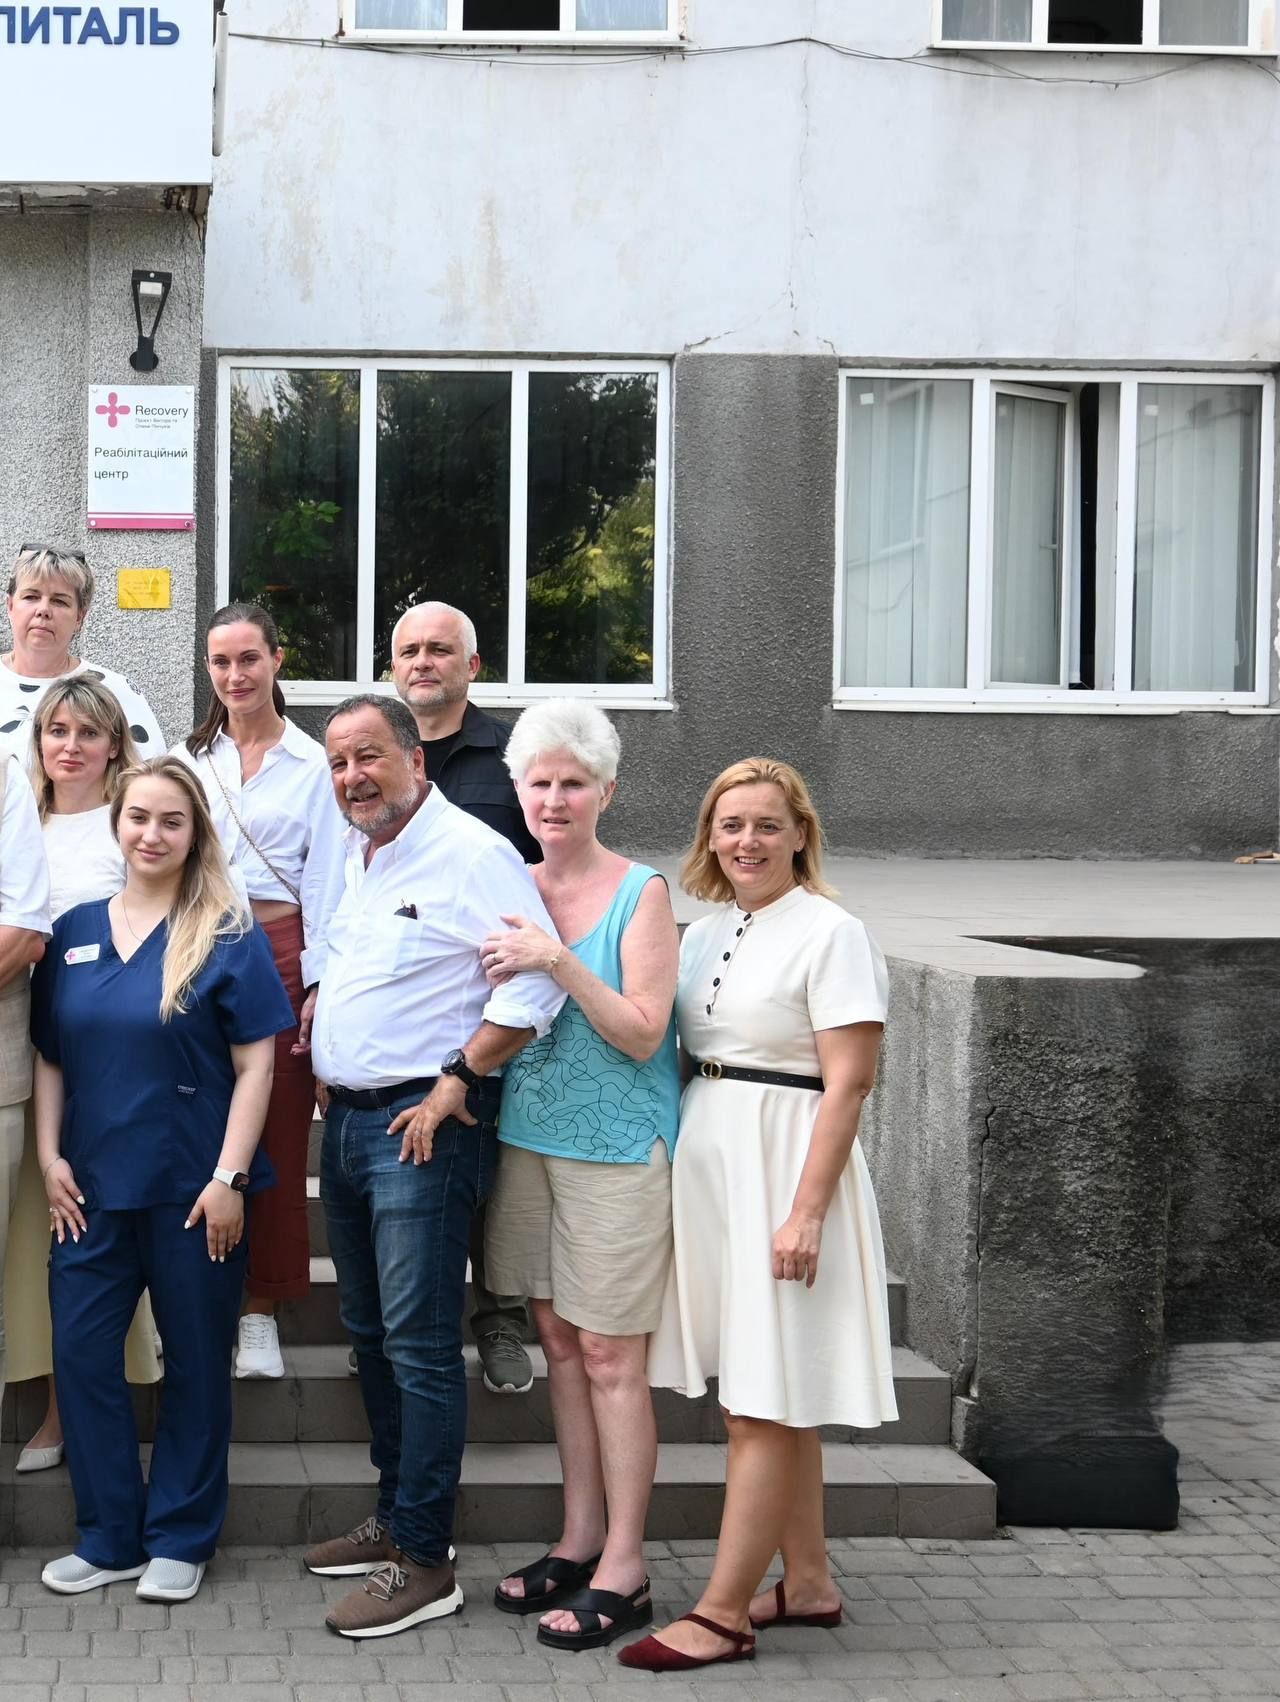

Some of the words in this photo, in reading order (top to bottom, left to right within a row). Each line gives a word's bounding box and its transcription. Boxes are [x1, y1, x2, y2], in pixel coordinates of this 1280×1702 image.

[135, 405, 189, 418] Recovery
[94, 447, 188, 459] Реабілітаційний
[94, 470, 129, 480] центр
